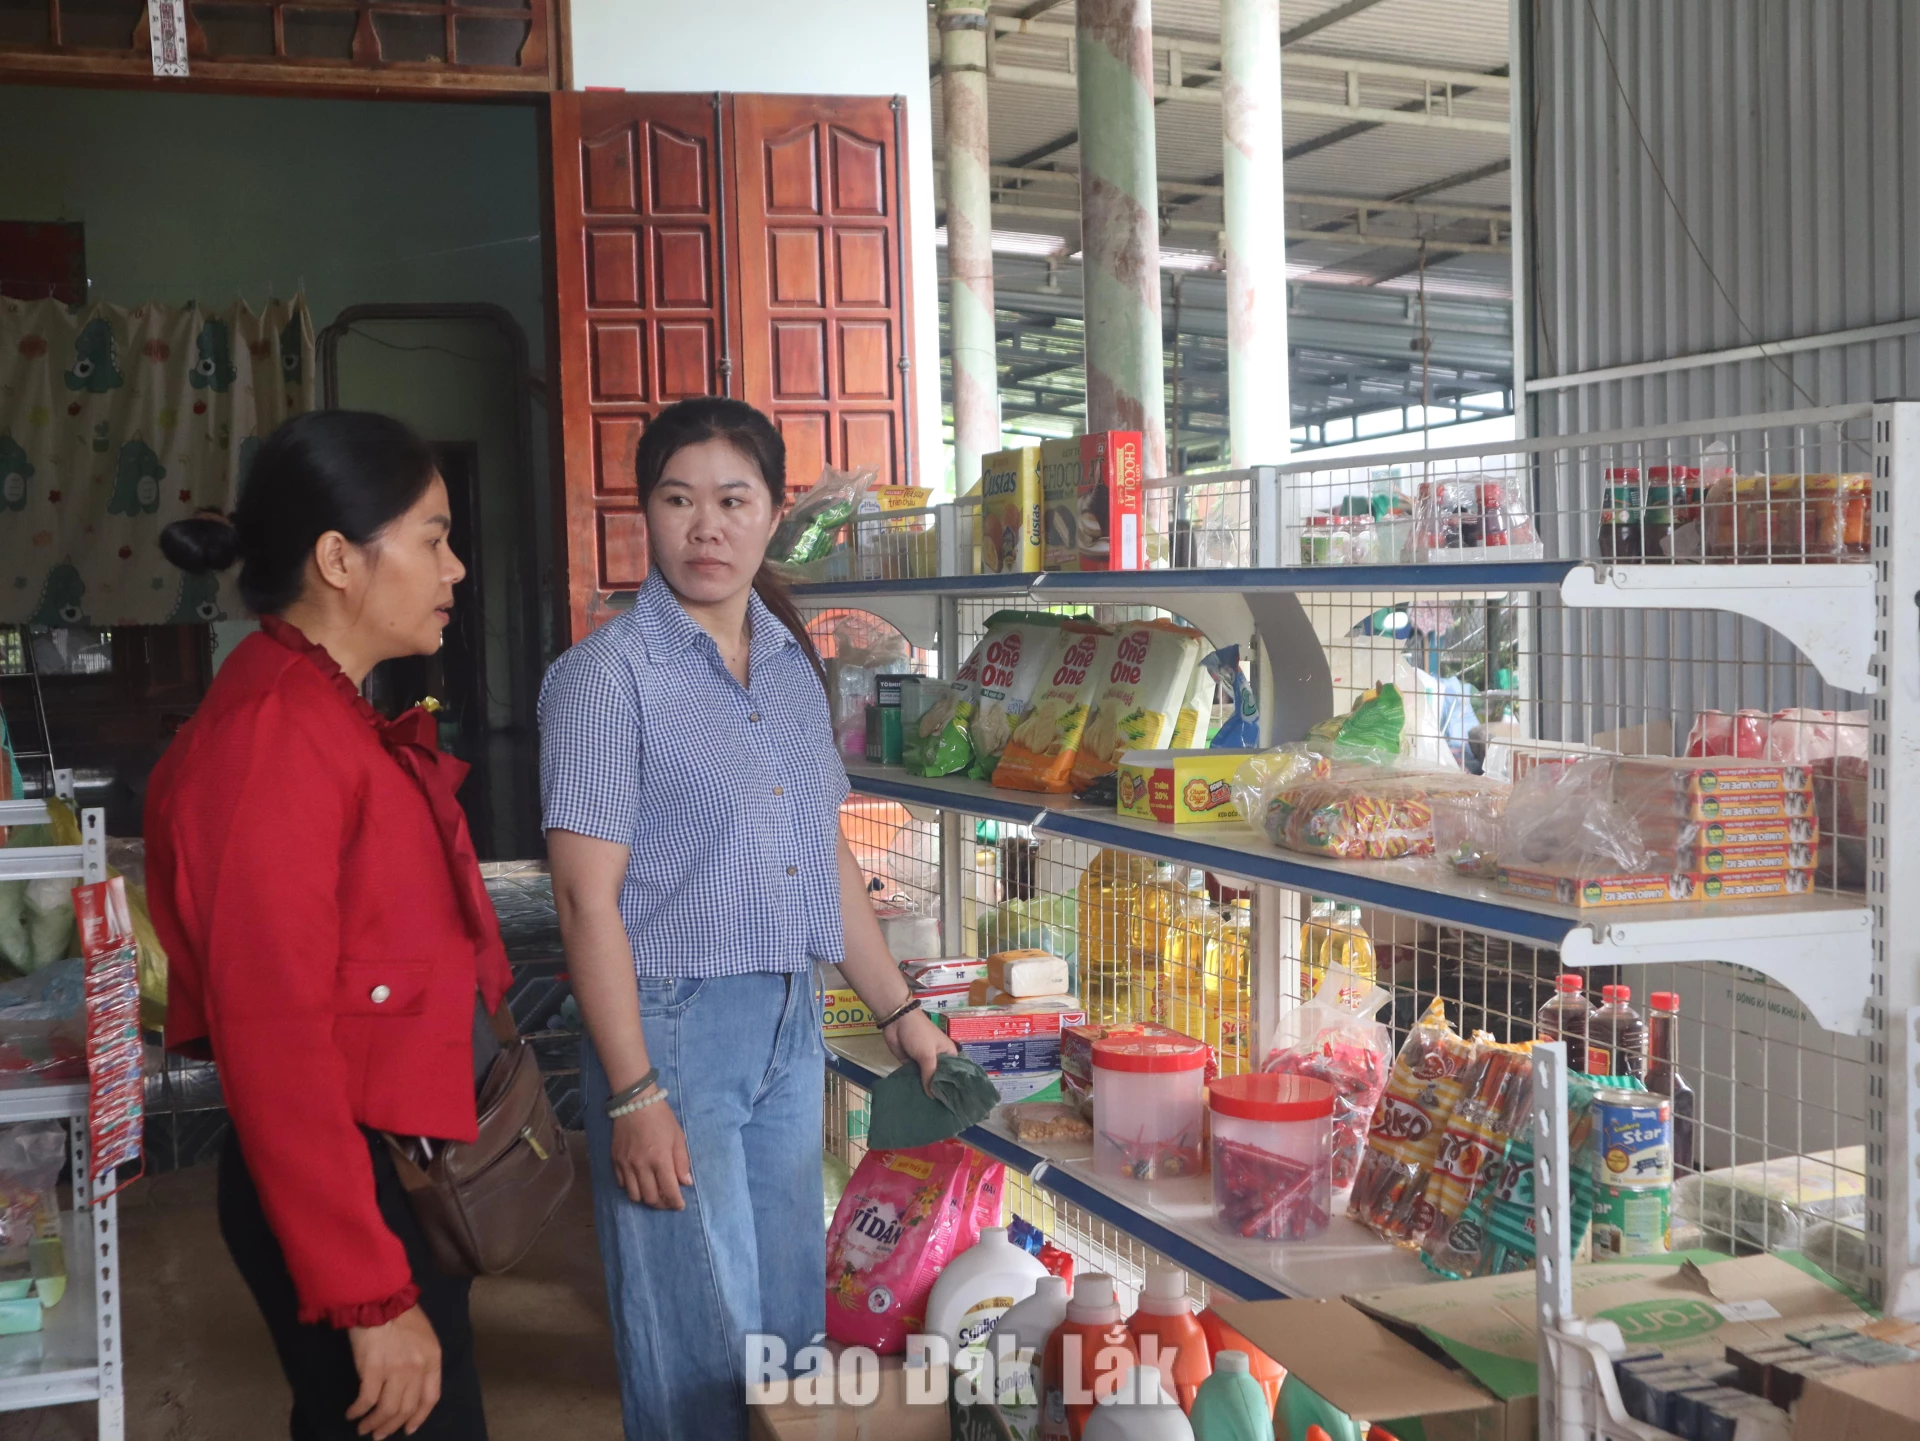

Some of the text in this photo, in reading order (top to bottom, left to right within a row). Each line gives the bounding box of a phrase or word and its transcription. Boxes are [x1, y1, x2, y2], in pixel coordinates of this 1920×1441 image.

[982, 468, 1017, 498] Custas
[1124, 442, 1136, 510] CHOCOLAT
[1030, 504, 1041, 547] Custas
[986, 641, 1020, 668] One
[1063, 644, 1095, 668] One
[1117, 636, 1147, 665] One
[981, 664, 1014, 688] One
[1052, 665, 1086, 686] One
[1110, 660, 1141, 685] One
[1154, 791, 1169, 800] 20%
[822, 1009, 864, 1025] OOD
[1622, 1127, 1662, 1145] Star
[958, 1315, 1001, 1349] Sunlig
